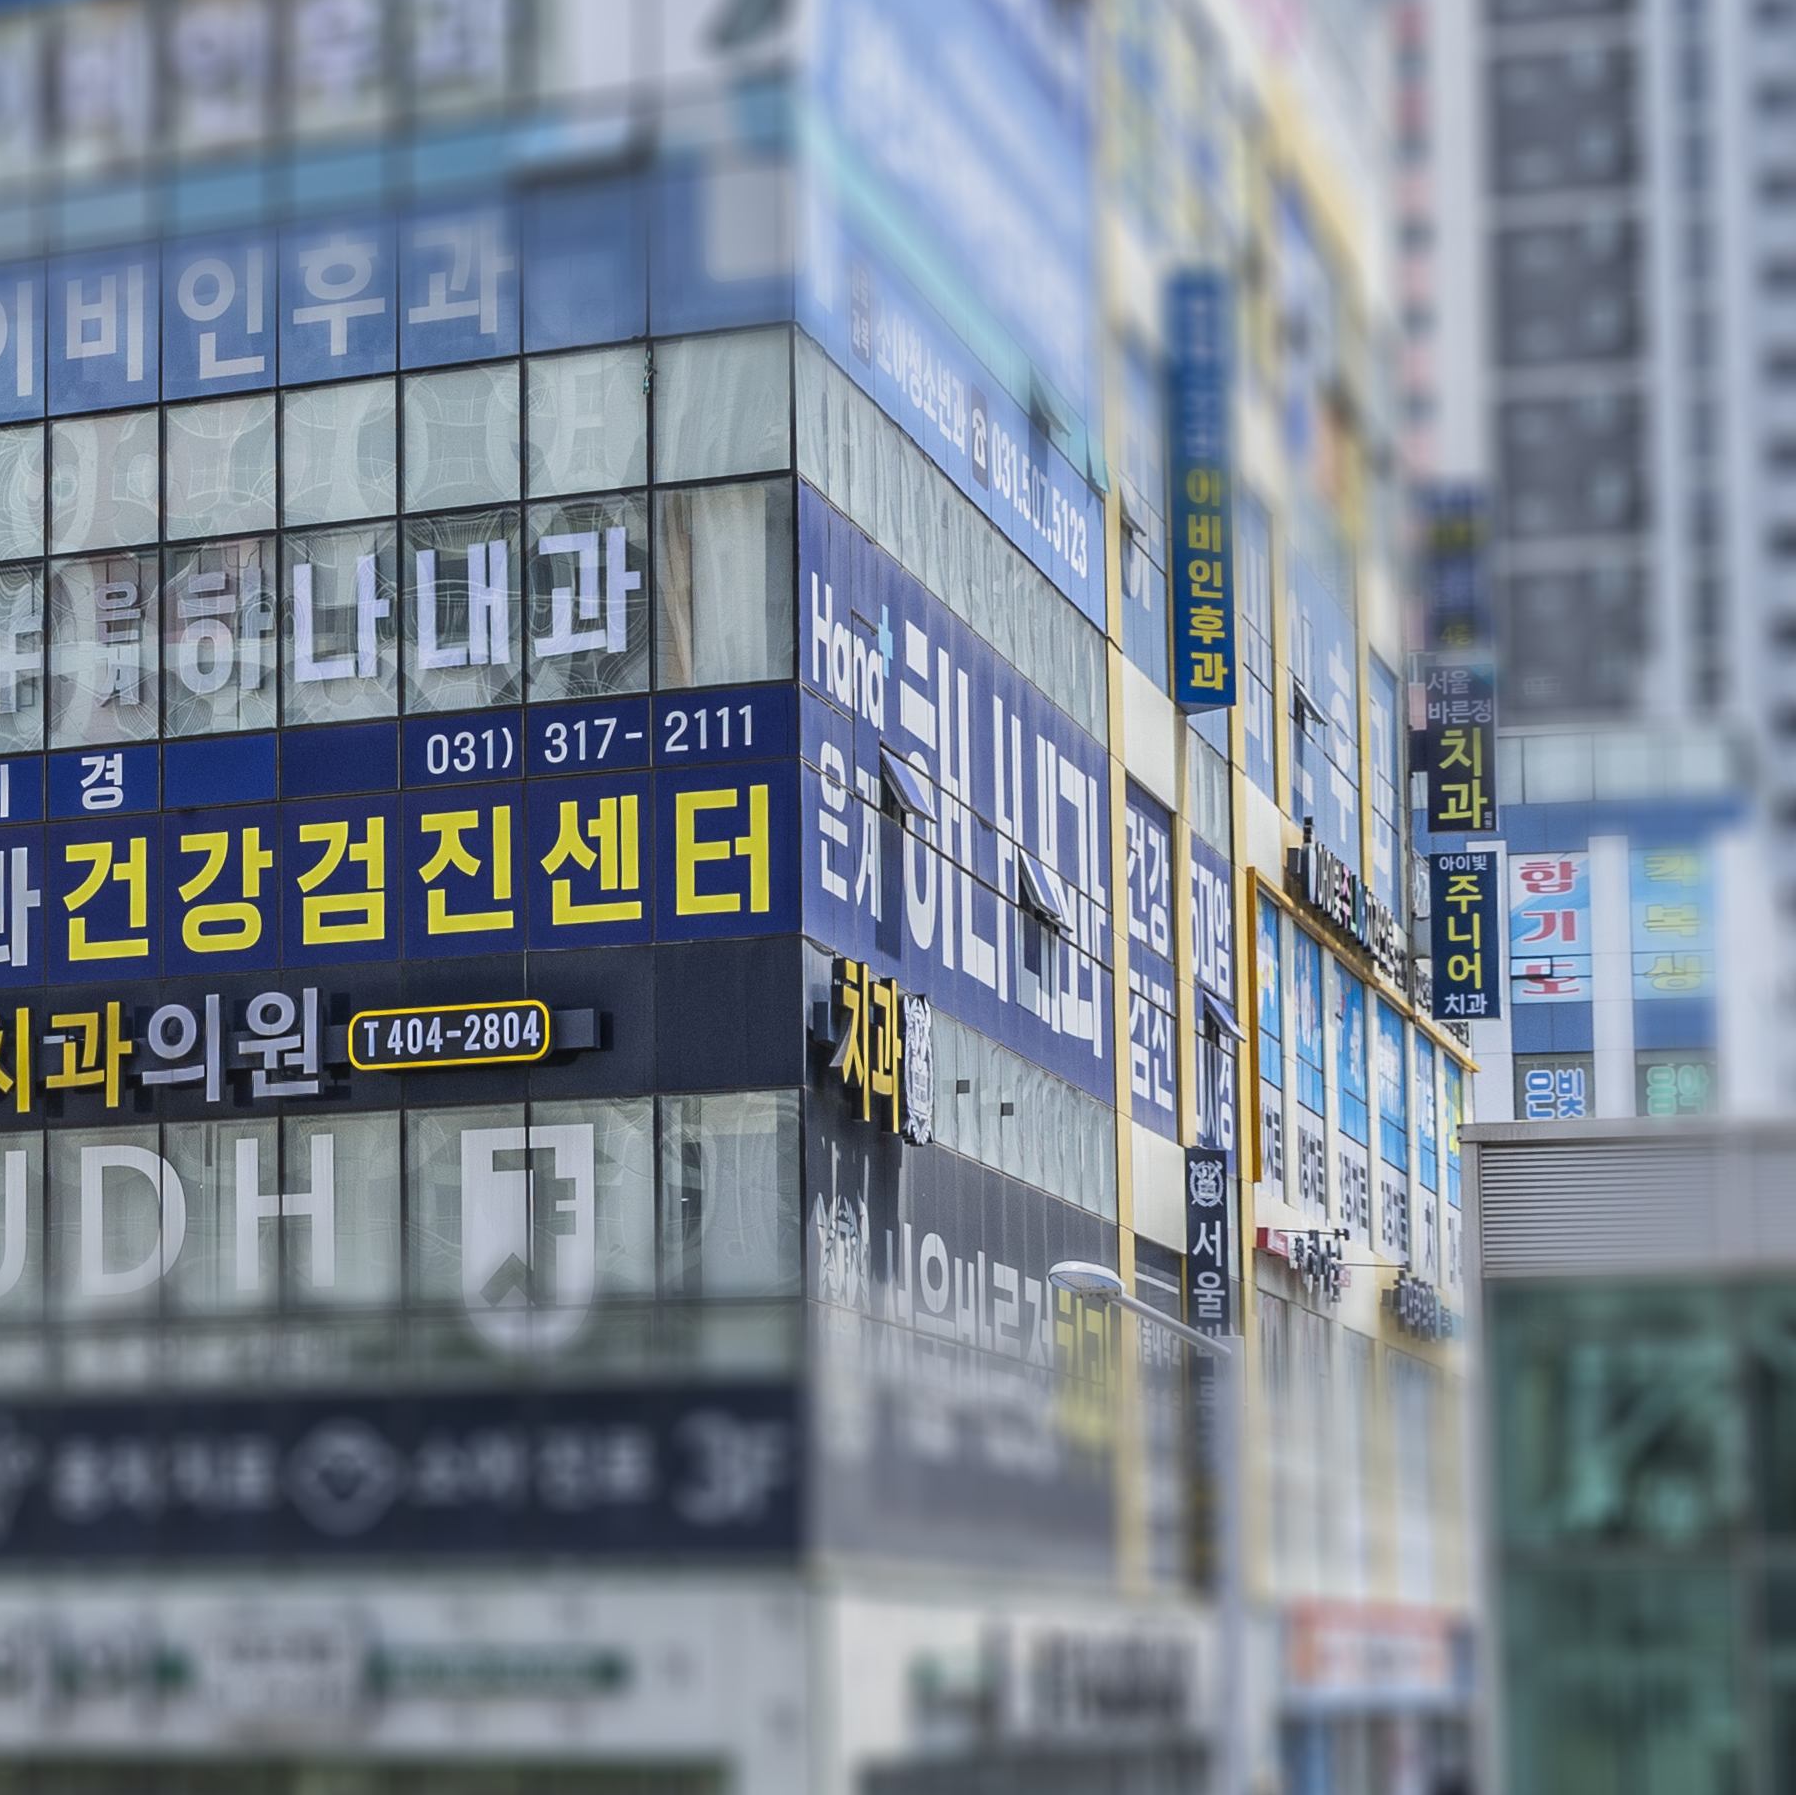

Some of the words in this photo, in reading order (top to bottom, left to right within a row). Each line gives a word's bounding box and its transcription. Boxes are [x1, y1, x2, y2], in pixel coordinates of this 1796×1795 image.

[1186, 468, 1229, 692] 이비인후과
[811, 571, 885, 732] Hana
[1426, 669, 1472, 696] 서울
[1427, 698, 1493, 726] 바른정
[426, 727, 515, 777] 031)
[1437, 726, 1489, 829] 치과
[1438, 854, 1488, 872] 아이빛
[1445, 874, 1483, 990] 주니어
[1519, 860, 1581, 995] 합기도
[1444, 993, 1488, 1016] 치과
[833, 959, 902, 1135] 치과
[1524, 1067, 1586, 1121] 은빛
